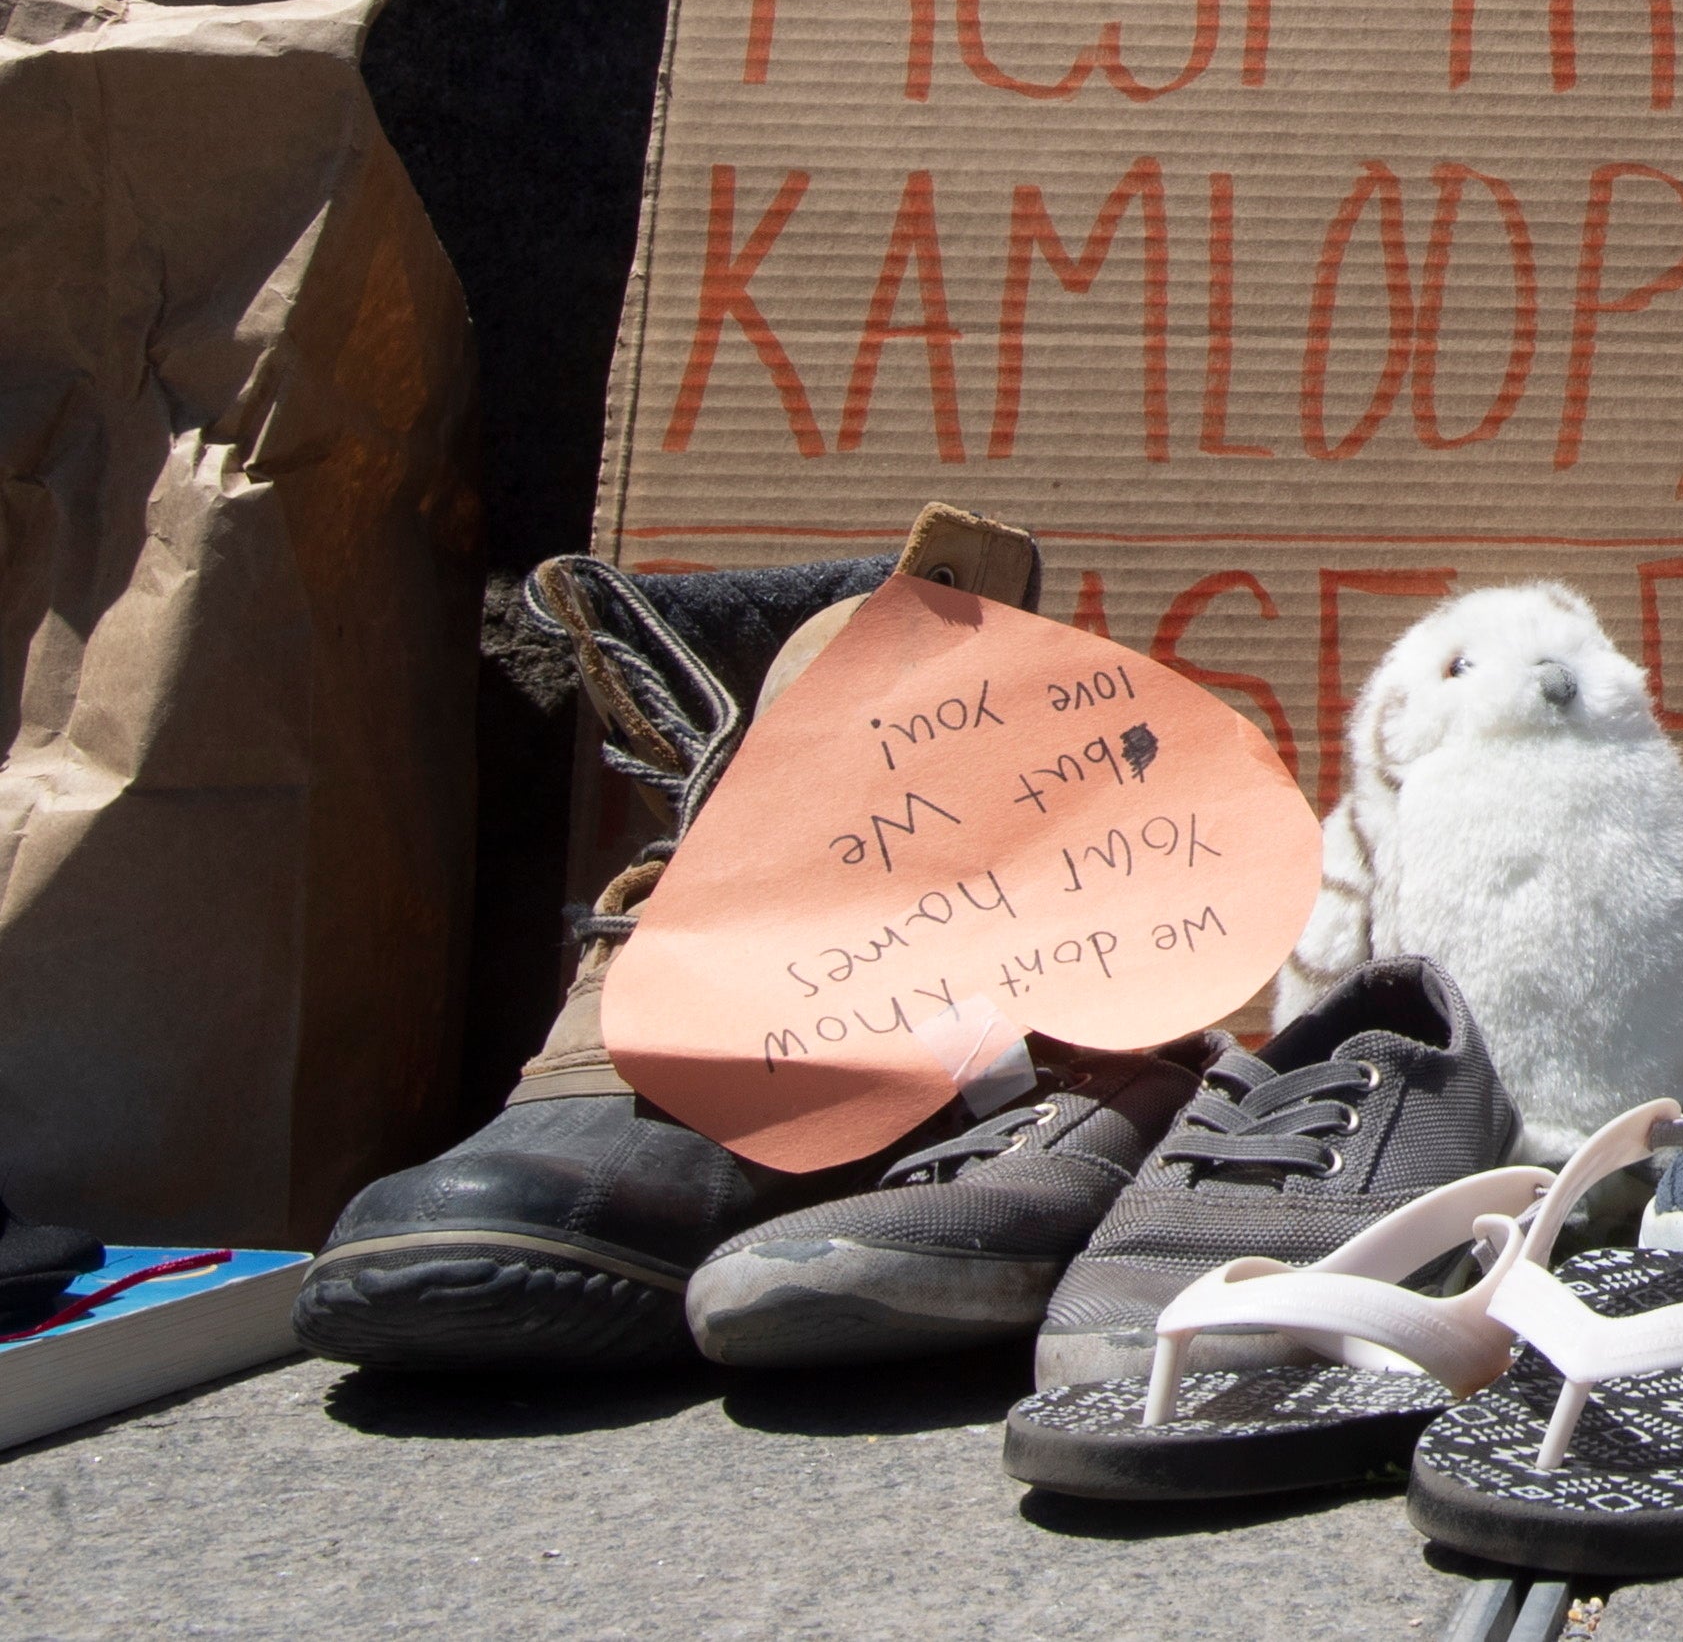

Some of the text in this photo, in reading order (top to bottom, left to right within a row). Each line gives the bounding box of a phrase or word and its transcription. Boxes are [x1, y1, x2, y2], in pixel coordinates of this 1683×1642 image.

[1047, 664, 1136, 715] love
[1013, 736, 1124, 816] but
[786, 870, 1018, 1000] names
